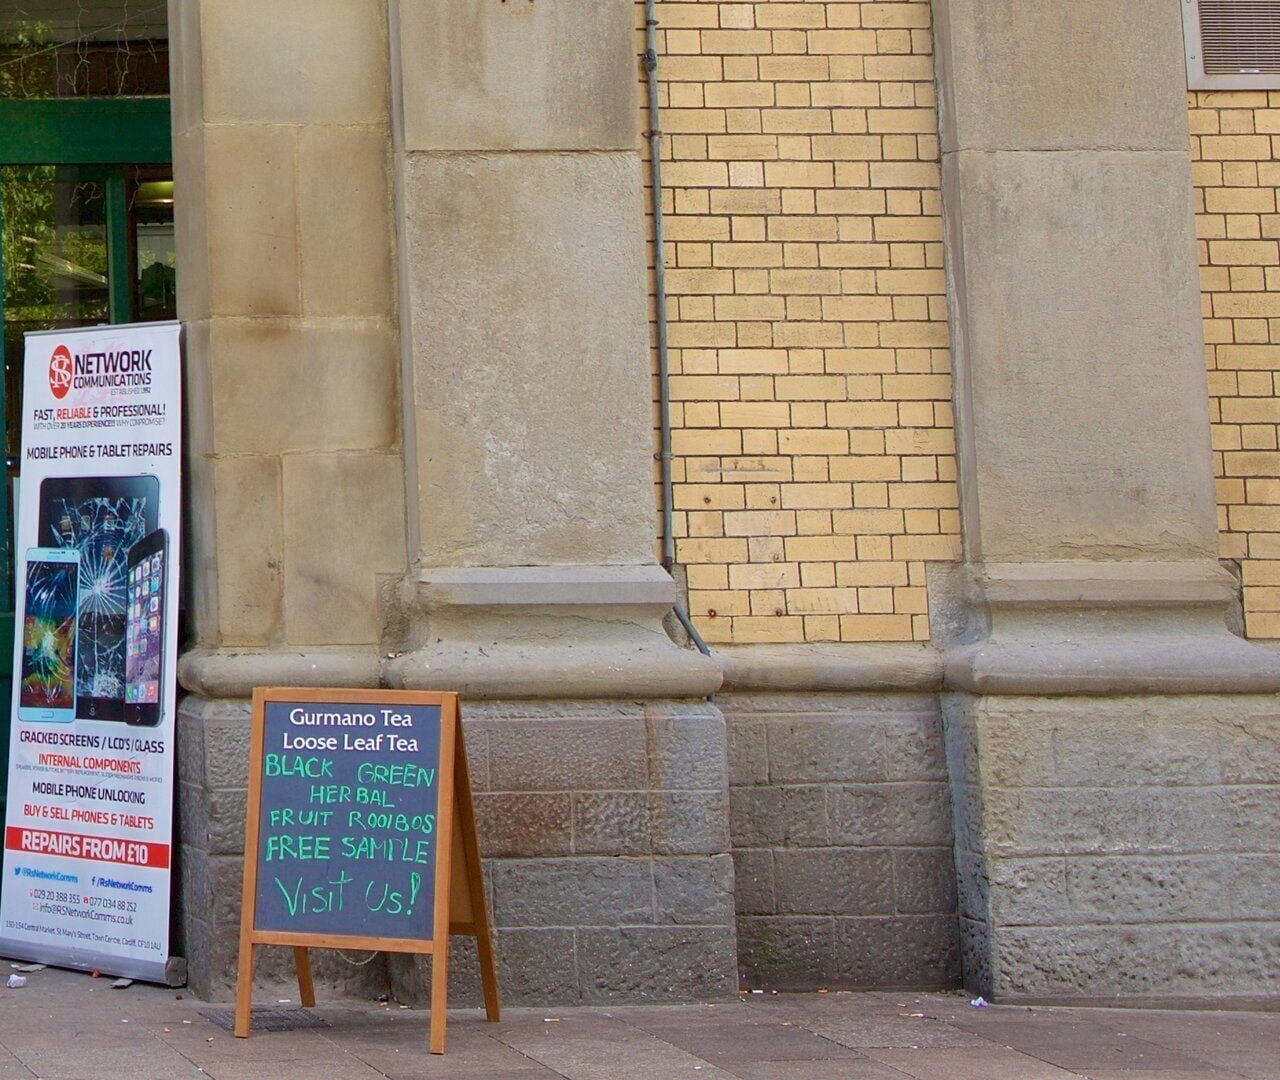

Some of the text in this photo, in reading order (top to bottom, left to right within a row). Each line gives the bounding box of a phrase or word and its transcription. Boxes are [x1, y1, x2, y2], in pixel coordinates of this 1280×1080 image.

[74, 350, 152, 375] NETWORK
[73, 373, 152, 389] COMMUNICATIONS
[34, 404, 166, 421] FAST, RELIABLE & PROFESSIONAL!
[27, 443, 172, 459] MOBILE PHONE & TABLET REPAIRS
[290, 708, 413, 727] Gurmano Tea
[20, 731, 59, 745] CRACKED
[59, 734, 100, 748] SCREENS
[135, 740, 164, 754] GLASS
[283, 733, 419, 751] Loose Leaf Tea
[39, 754, 81, 769] INTERNAL
[83, 757, 142, 774] COMPONENTS
[265, 753, 435, 787] BLACK GREEN
[32, 782, 145, 805] MOBILE PHONE UNLOCKING
[309, 784, 395, 808] HERBAL
[24, 804, 154, 830] BUY & SELL PHONES & TABLETS
[270, 808, 435, 834] FRUIT ROOIBOS
[21, 830, 148, 864] REPAIRS FROM £10
[266, 834, 429, 865] FREE SAMPLE
